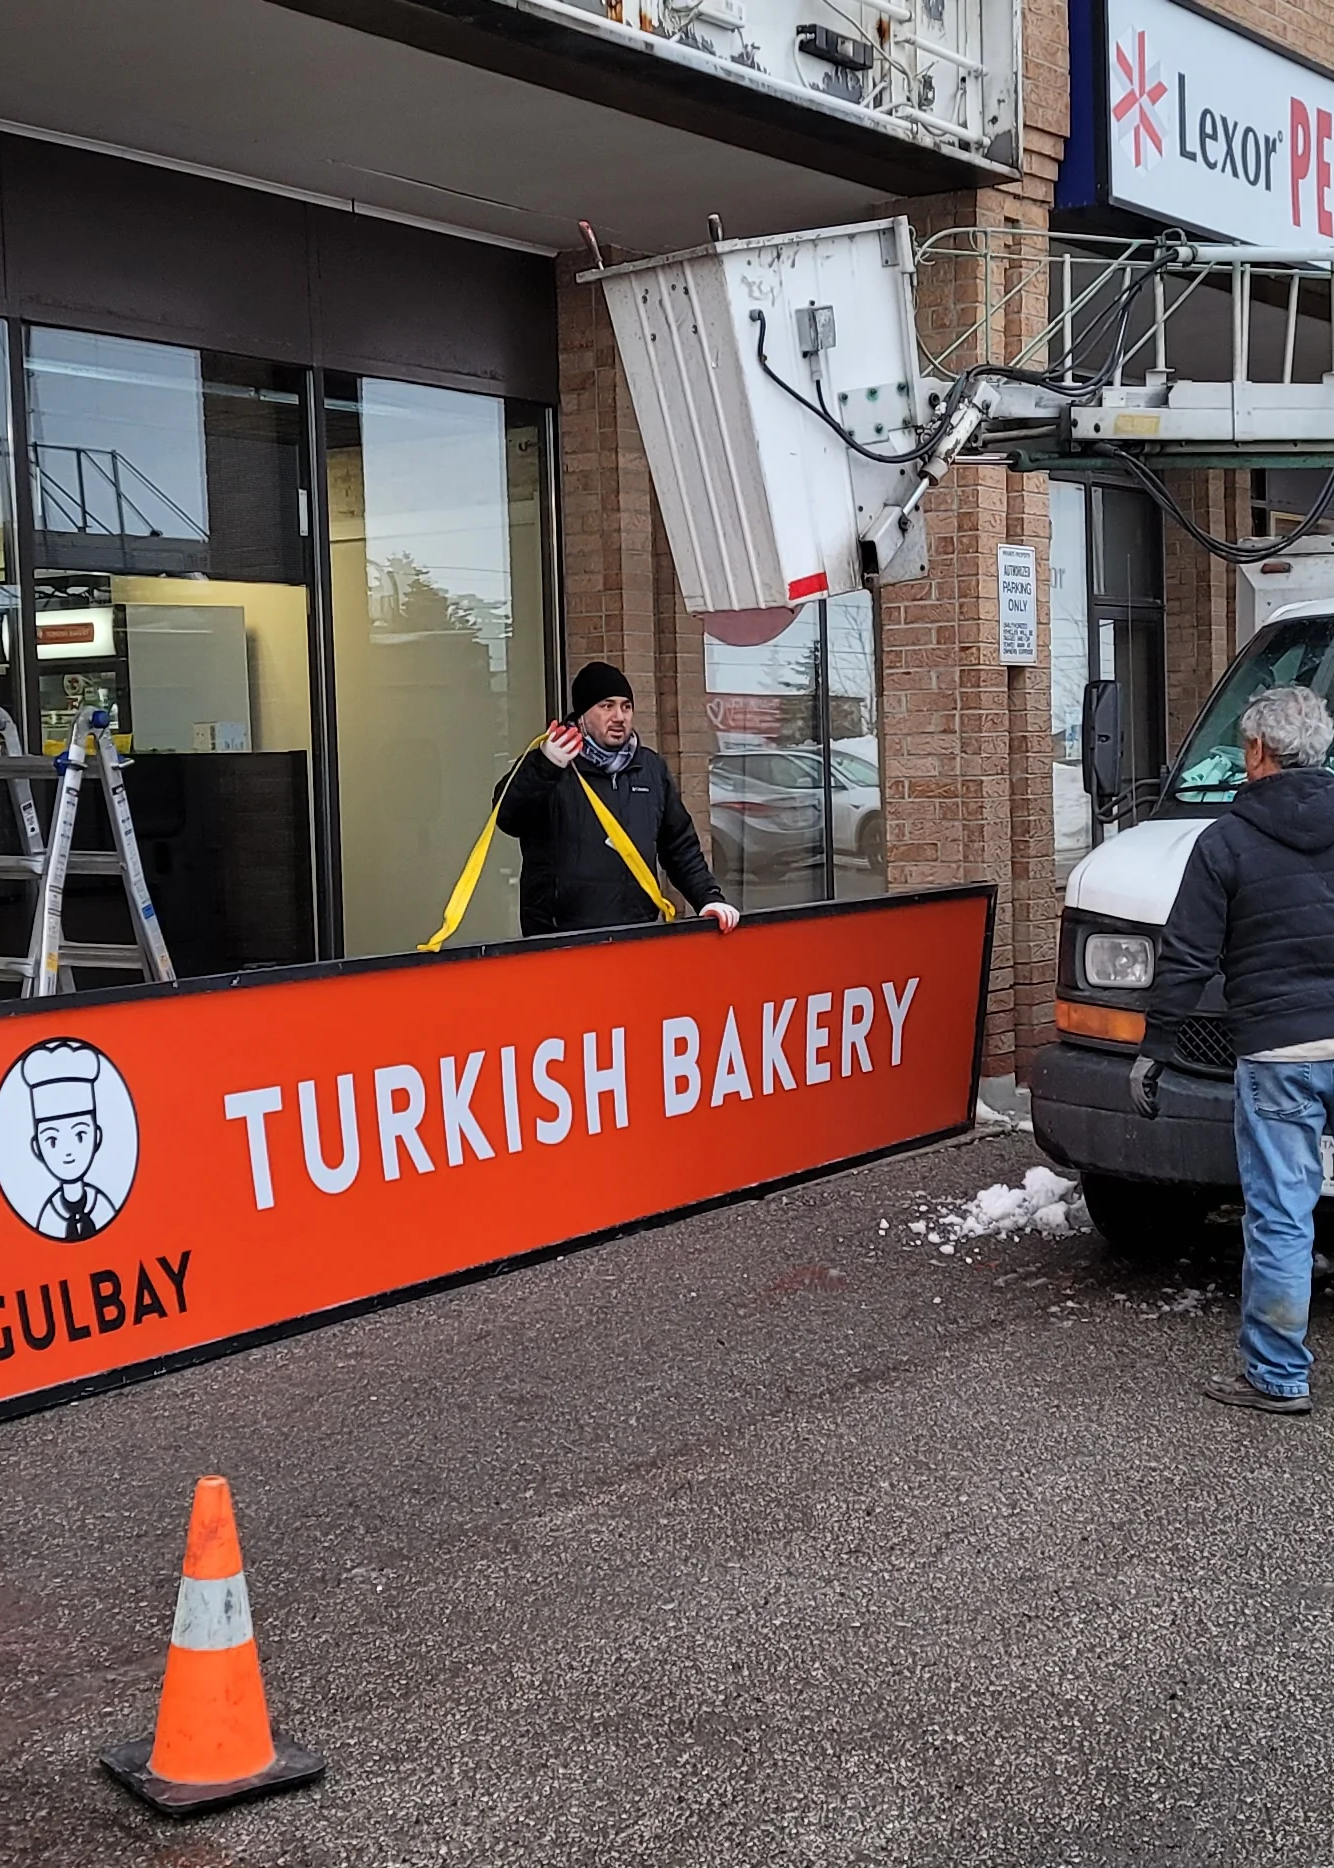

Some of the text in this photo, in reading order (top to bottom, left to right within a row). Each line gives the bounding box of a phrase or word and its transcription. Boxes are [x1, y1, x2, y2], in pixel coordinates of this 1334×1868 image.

[1002, 581, 1032, 595] PARKING
[1008, 598, 1028, 612] ONLY
[223, 977, 920, 1211] TURKISH BAKERY
